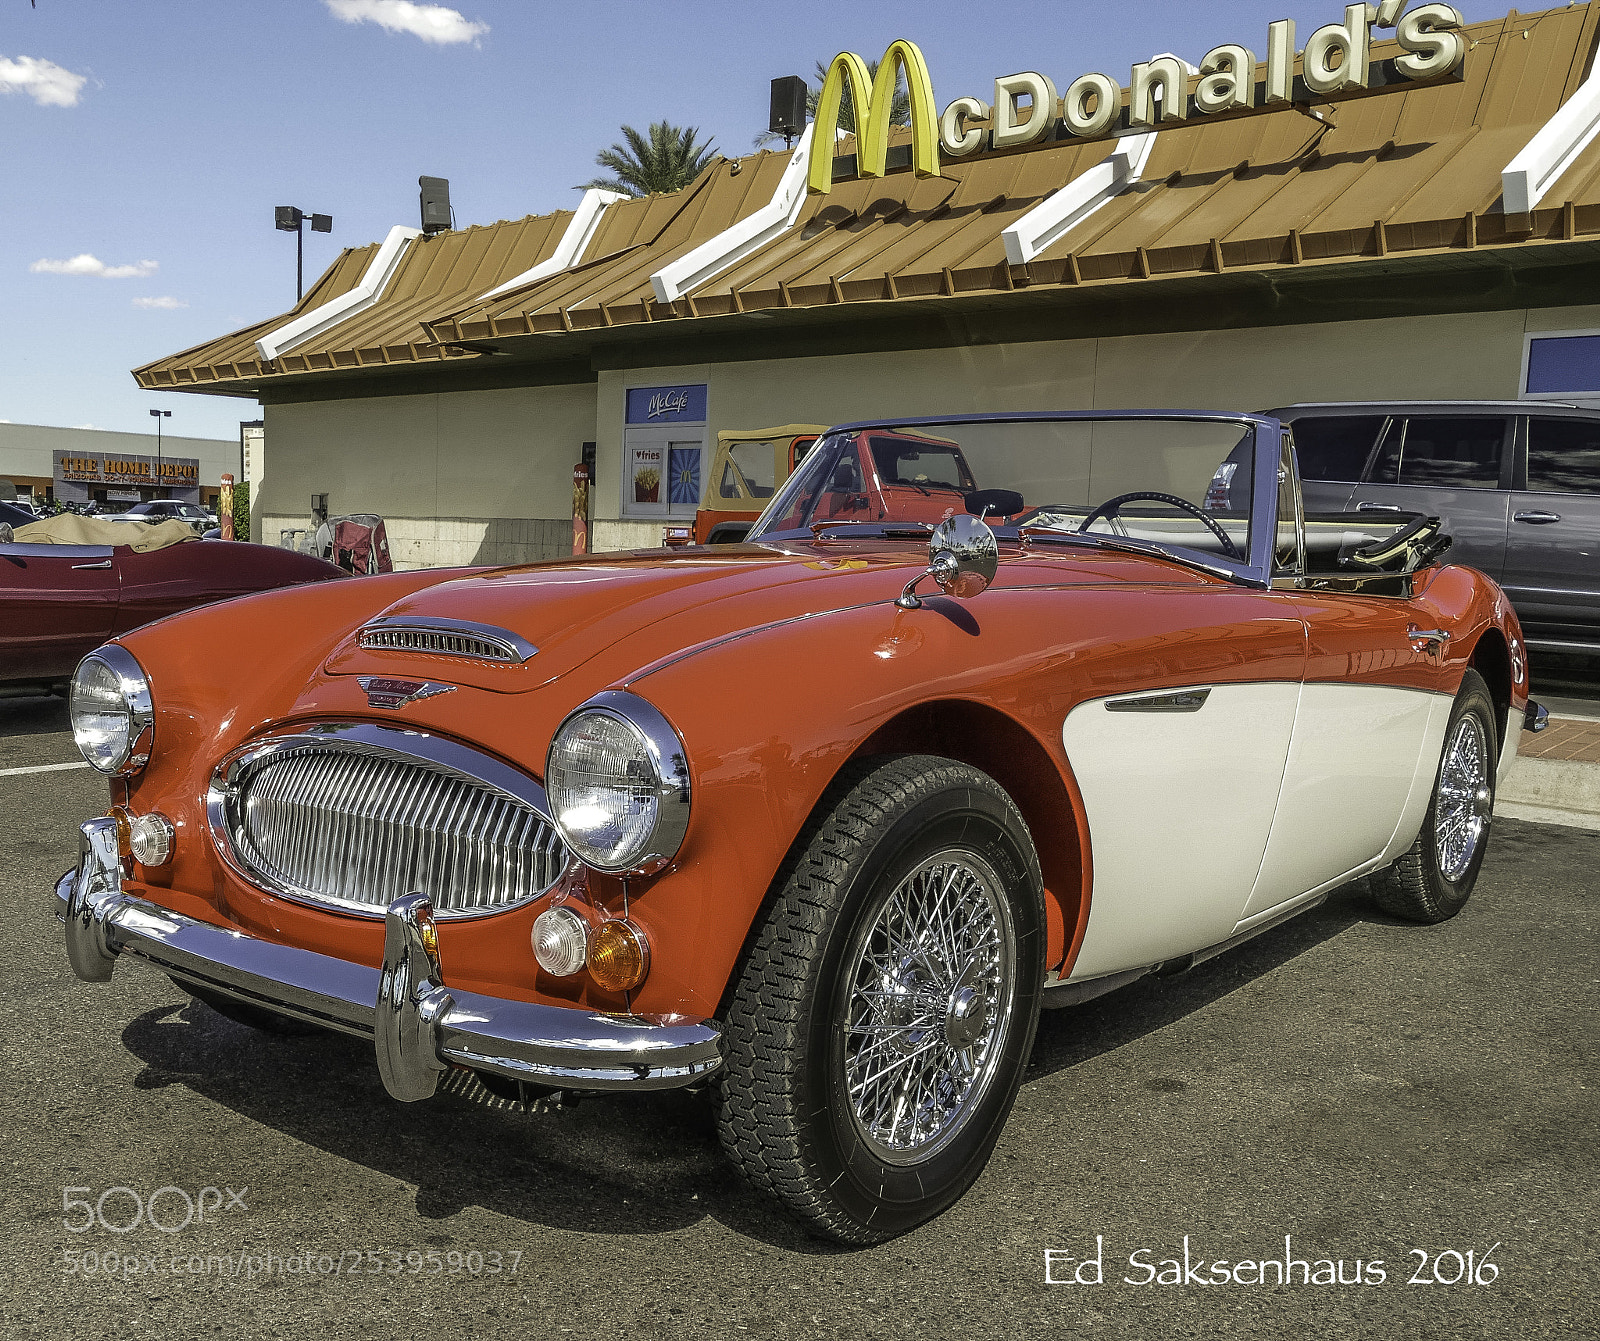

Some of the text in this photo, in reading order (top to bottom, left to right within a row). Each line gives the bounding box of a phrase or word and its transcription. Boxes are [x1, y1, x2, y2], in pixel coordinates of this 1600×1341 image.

[807, 1, 1465, 195] McDonald's
[648, 390, 689, 417] McCafé
[642, 450, 660, 460] fries
[61, 457, 198, 478] THE HOME DEPOT
